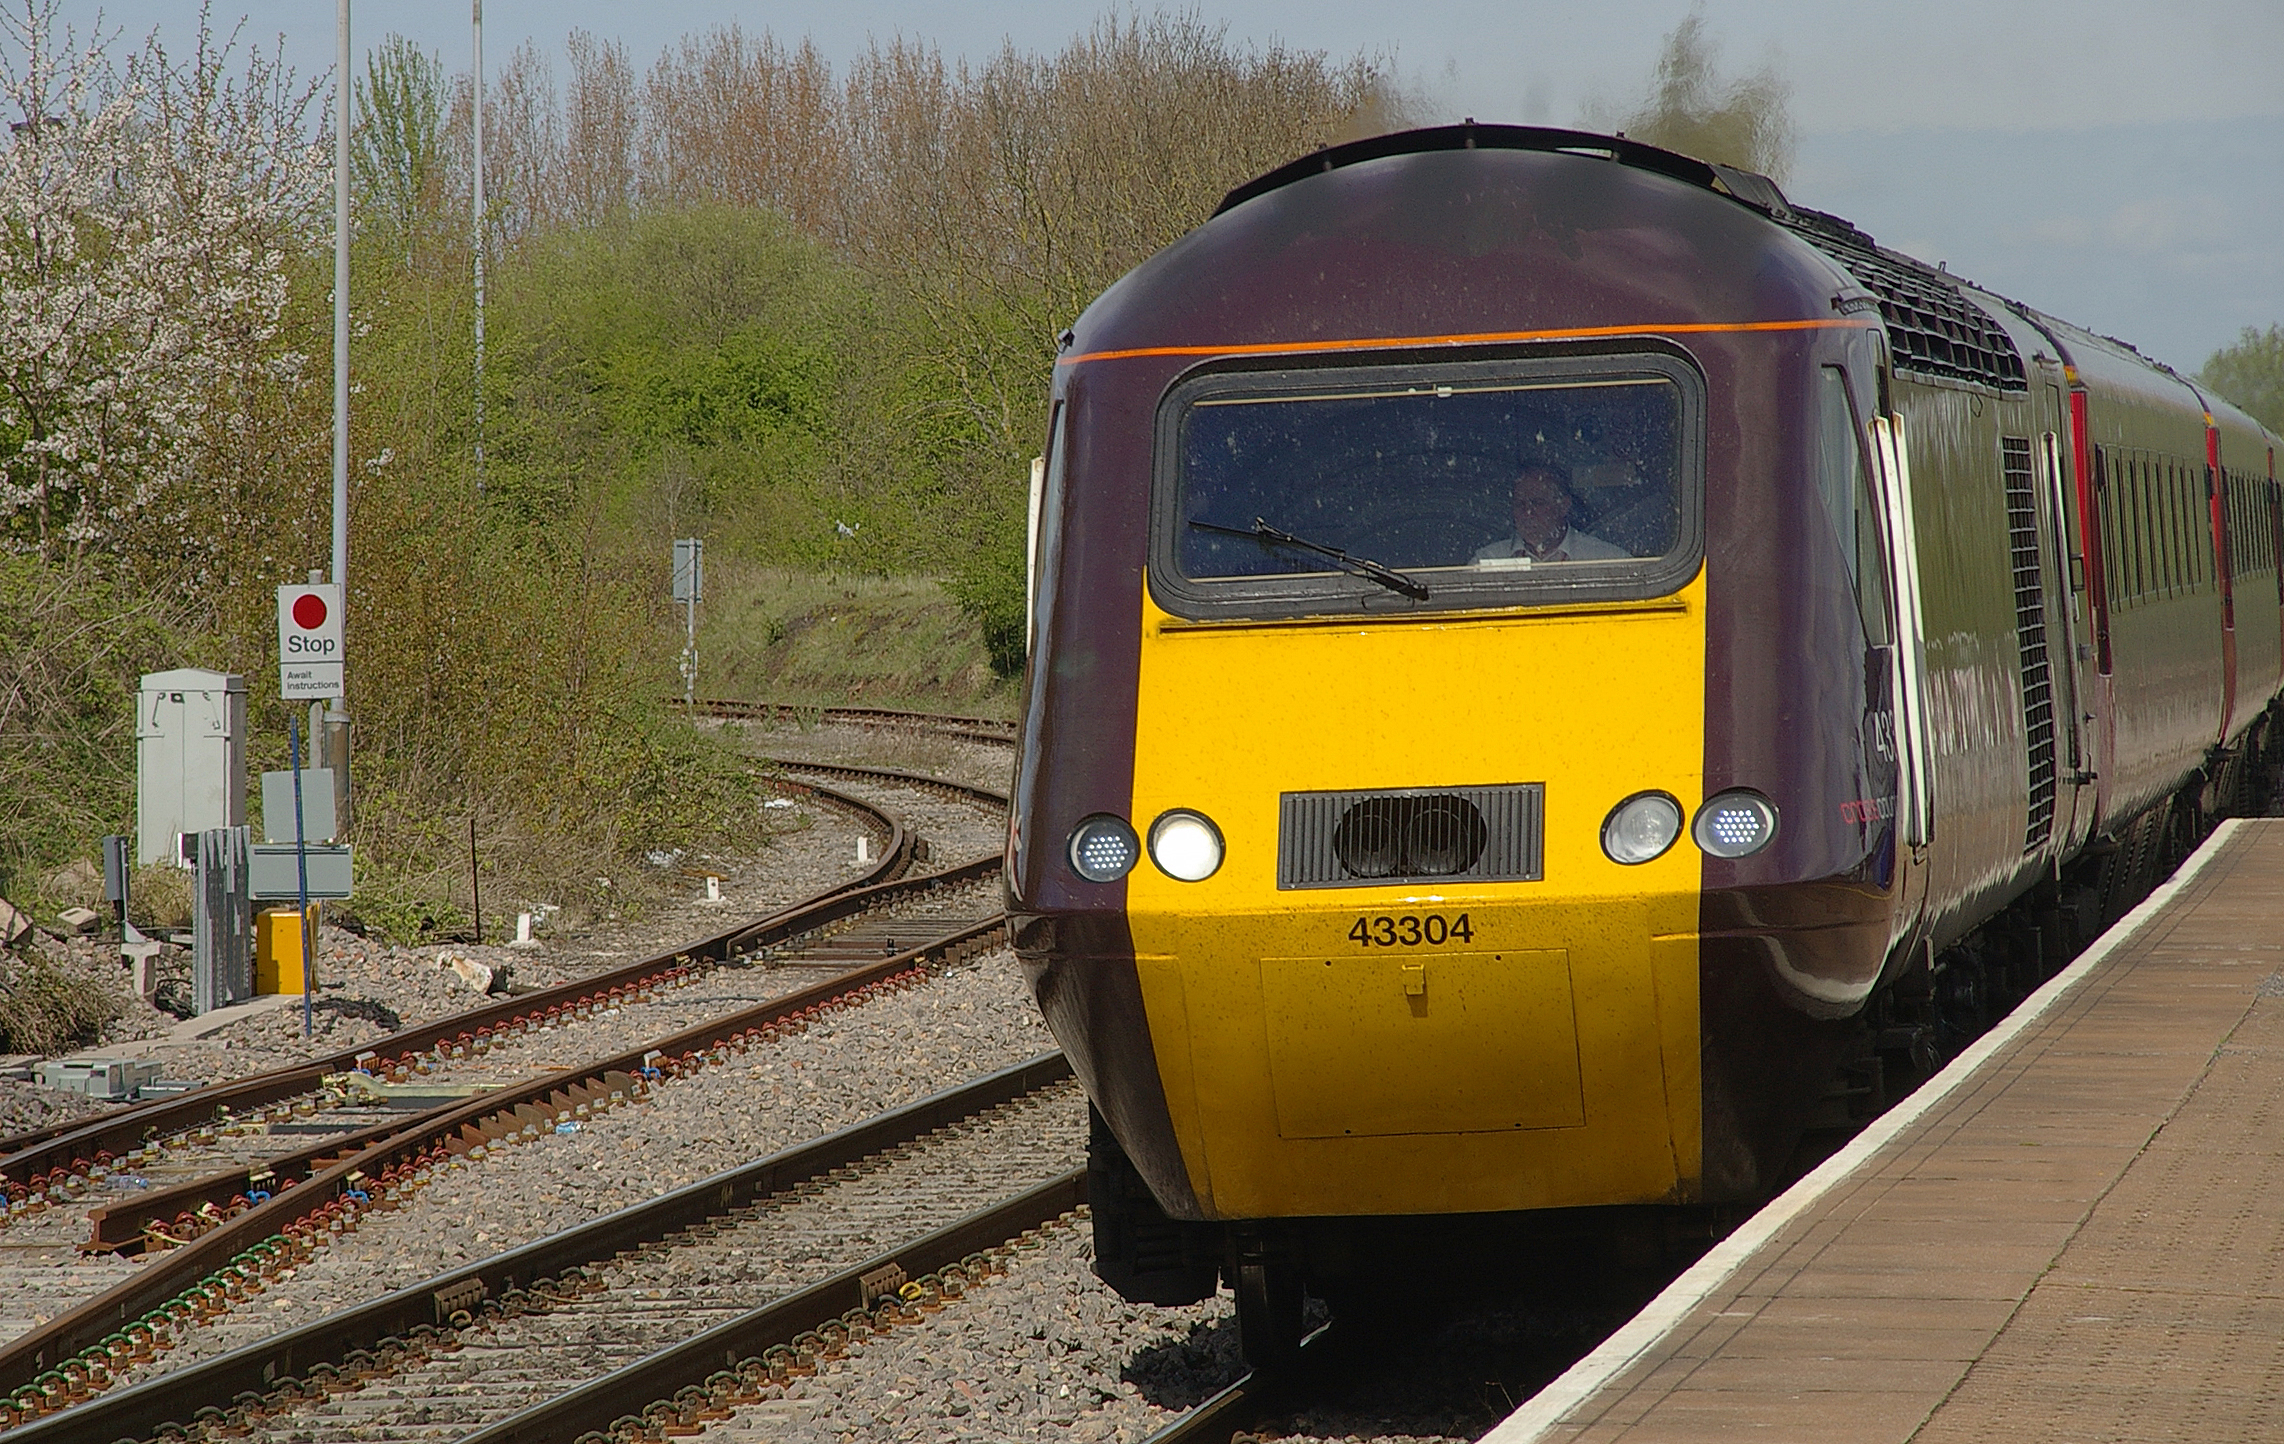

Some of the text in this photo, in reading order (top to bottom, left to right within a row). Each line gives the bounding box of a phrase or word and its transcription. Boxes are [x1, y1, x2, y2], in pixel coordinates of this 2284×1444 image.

[288, 635, 335, 655] Stop
[287, 671, 312, 679] Await
[1348, 913, 1474, 947] 43304
